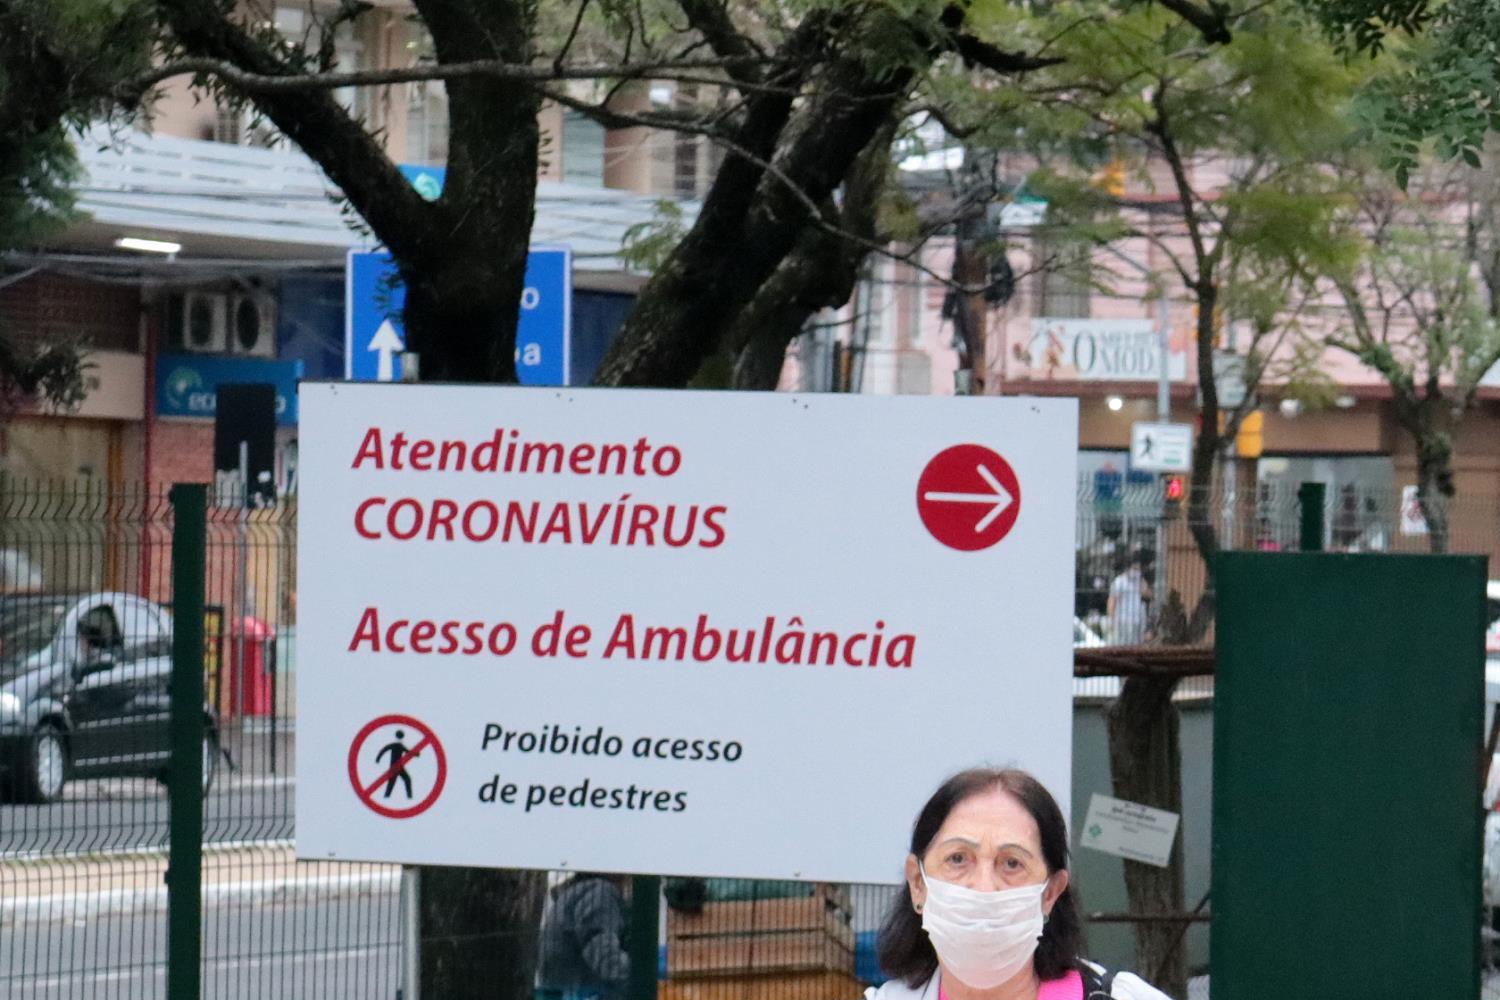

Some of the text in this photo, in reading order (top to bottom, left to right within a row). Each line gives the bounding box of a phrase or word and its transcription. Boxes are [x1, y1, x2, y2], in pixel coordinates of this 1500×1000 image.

[350, 427, 683, 478] Atendimento
[353, 493, 728, 549] CORONAVÍRUS
[347, 606, 917, 669] Acesso de Ambulância
[480, 722, 744, 763] Proibido acesso
[477, 773, 689, 814] de pedestres
